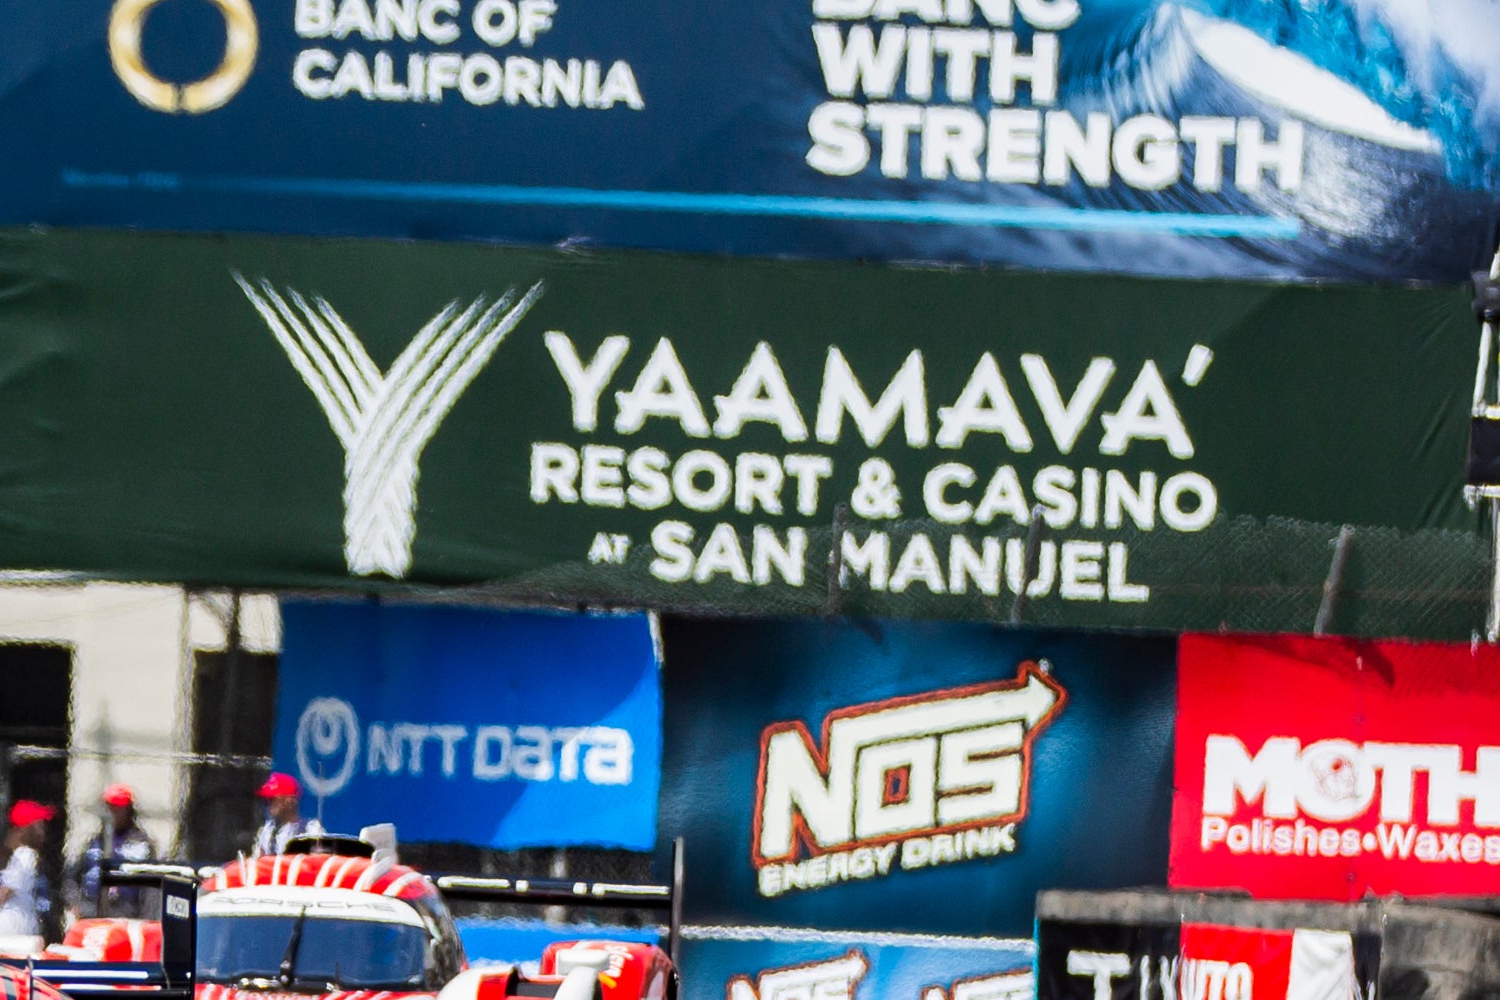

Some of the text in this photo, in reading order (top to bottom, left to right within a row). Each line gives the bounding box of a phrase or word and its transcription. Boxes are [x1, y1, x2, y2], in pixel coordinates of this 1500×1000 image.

[294, 0, 560, 47] BANC OF
[811, 21, 1061, 106] WITH
[292, 48, 646, 111] CALIFORNIA
[805, 101, 1303, 193] STRENGTH
[530, 441, 1219, 533] RESORT & CASINO
[587, 520, 1150, 603] AT SAN MANUEL
[366, 720, 469, 779] NTT
[752, 659, 1068, 868] NOS
[758, 821, 1018, 898] ENERGY DRINK
